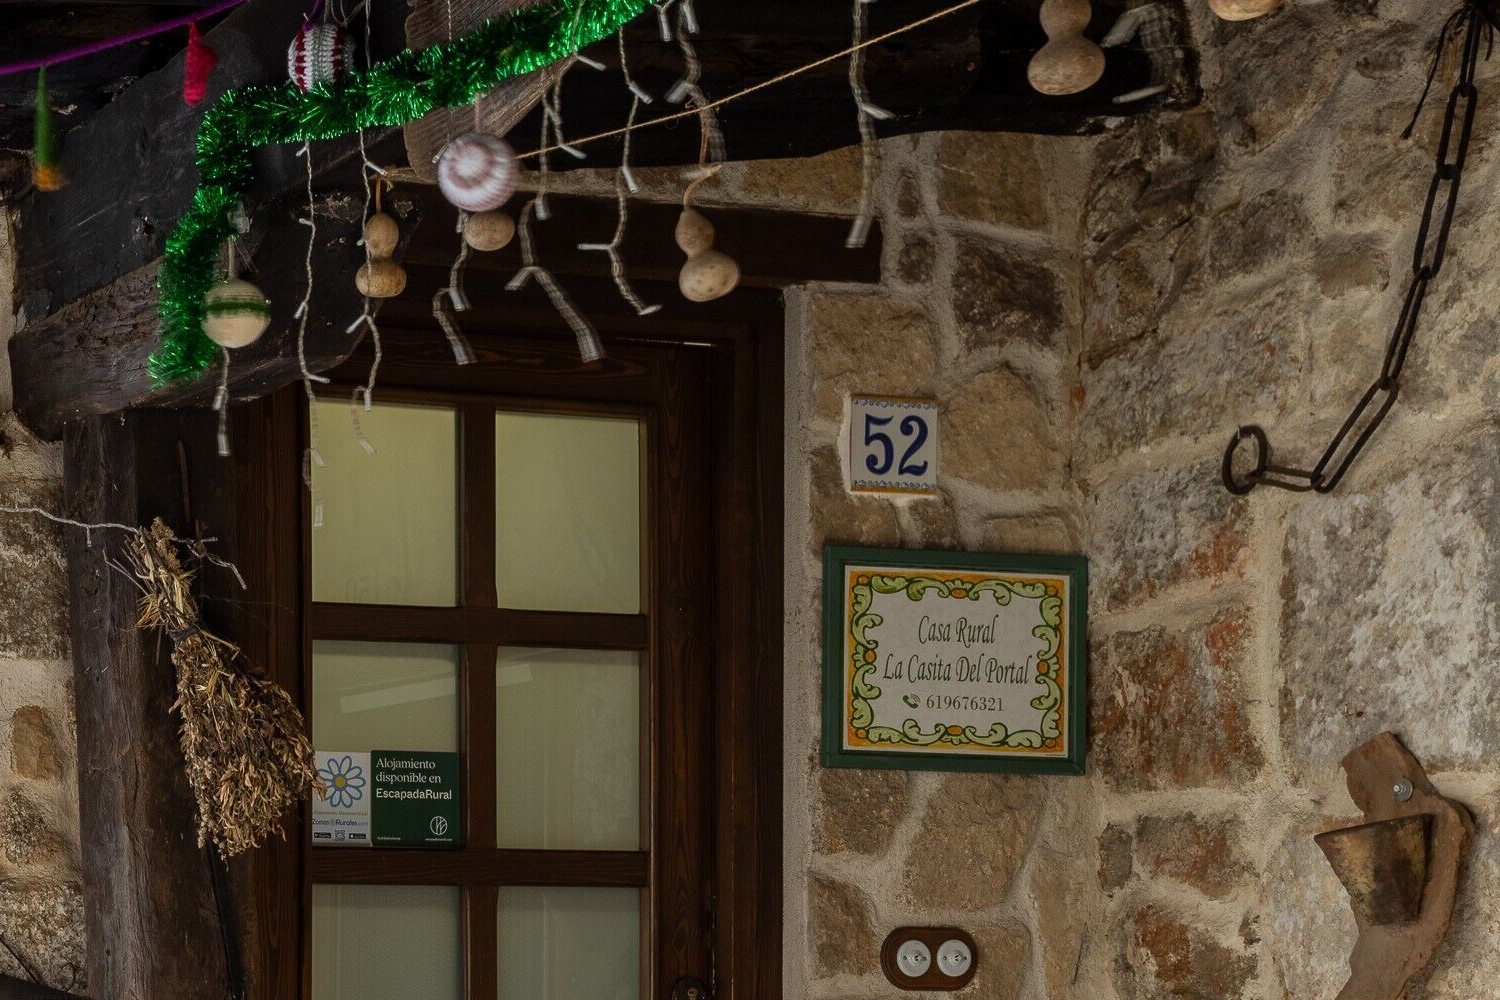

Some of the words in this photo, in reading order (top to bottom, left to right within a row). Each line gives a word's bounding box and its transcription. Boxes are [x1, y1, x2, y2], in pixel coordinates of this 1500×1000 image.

[864, 412, 929, 476] 52
[918, 615, 951, 644] Casa
[955, 614, 999, 649] Rural
[883, 653, 903, 680] La
[907, 654, 952, 684] Casita
[955, 653, 985, 683] Del
[985, 655, 1033, 685] Portal
[926, 694, 1004, 712] 619676321
[375, 757, 436, 771] Alojamiento
[375, 771, 427, 785] disponible
[428, 775, 442, 784] en
[376, 788, 452, 801] EscapadaRural
